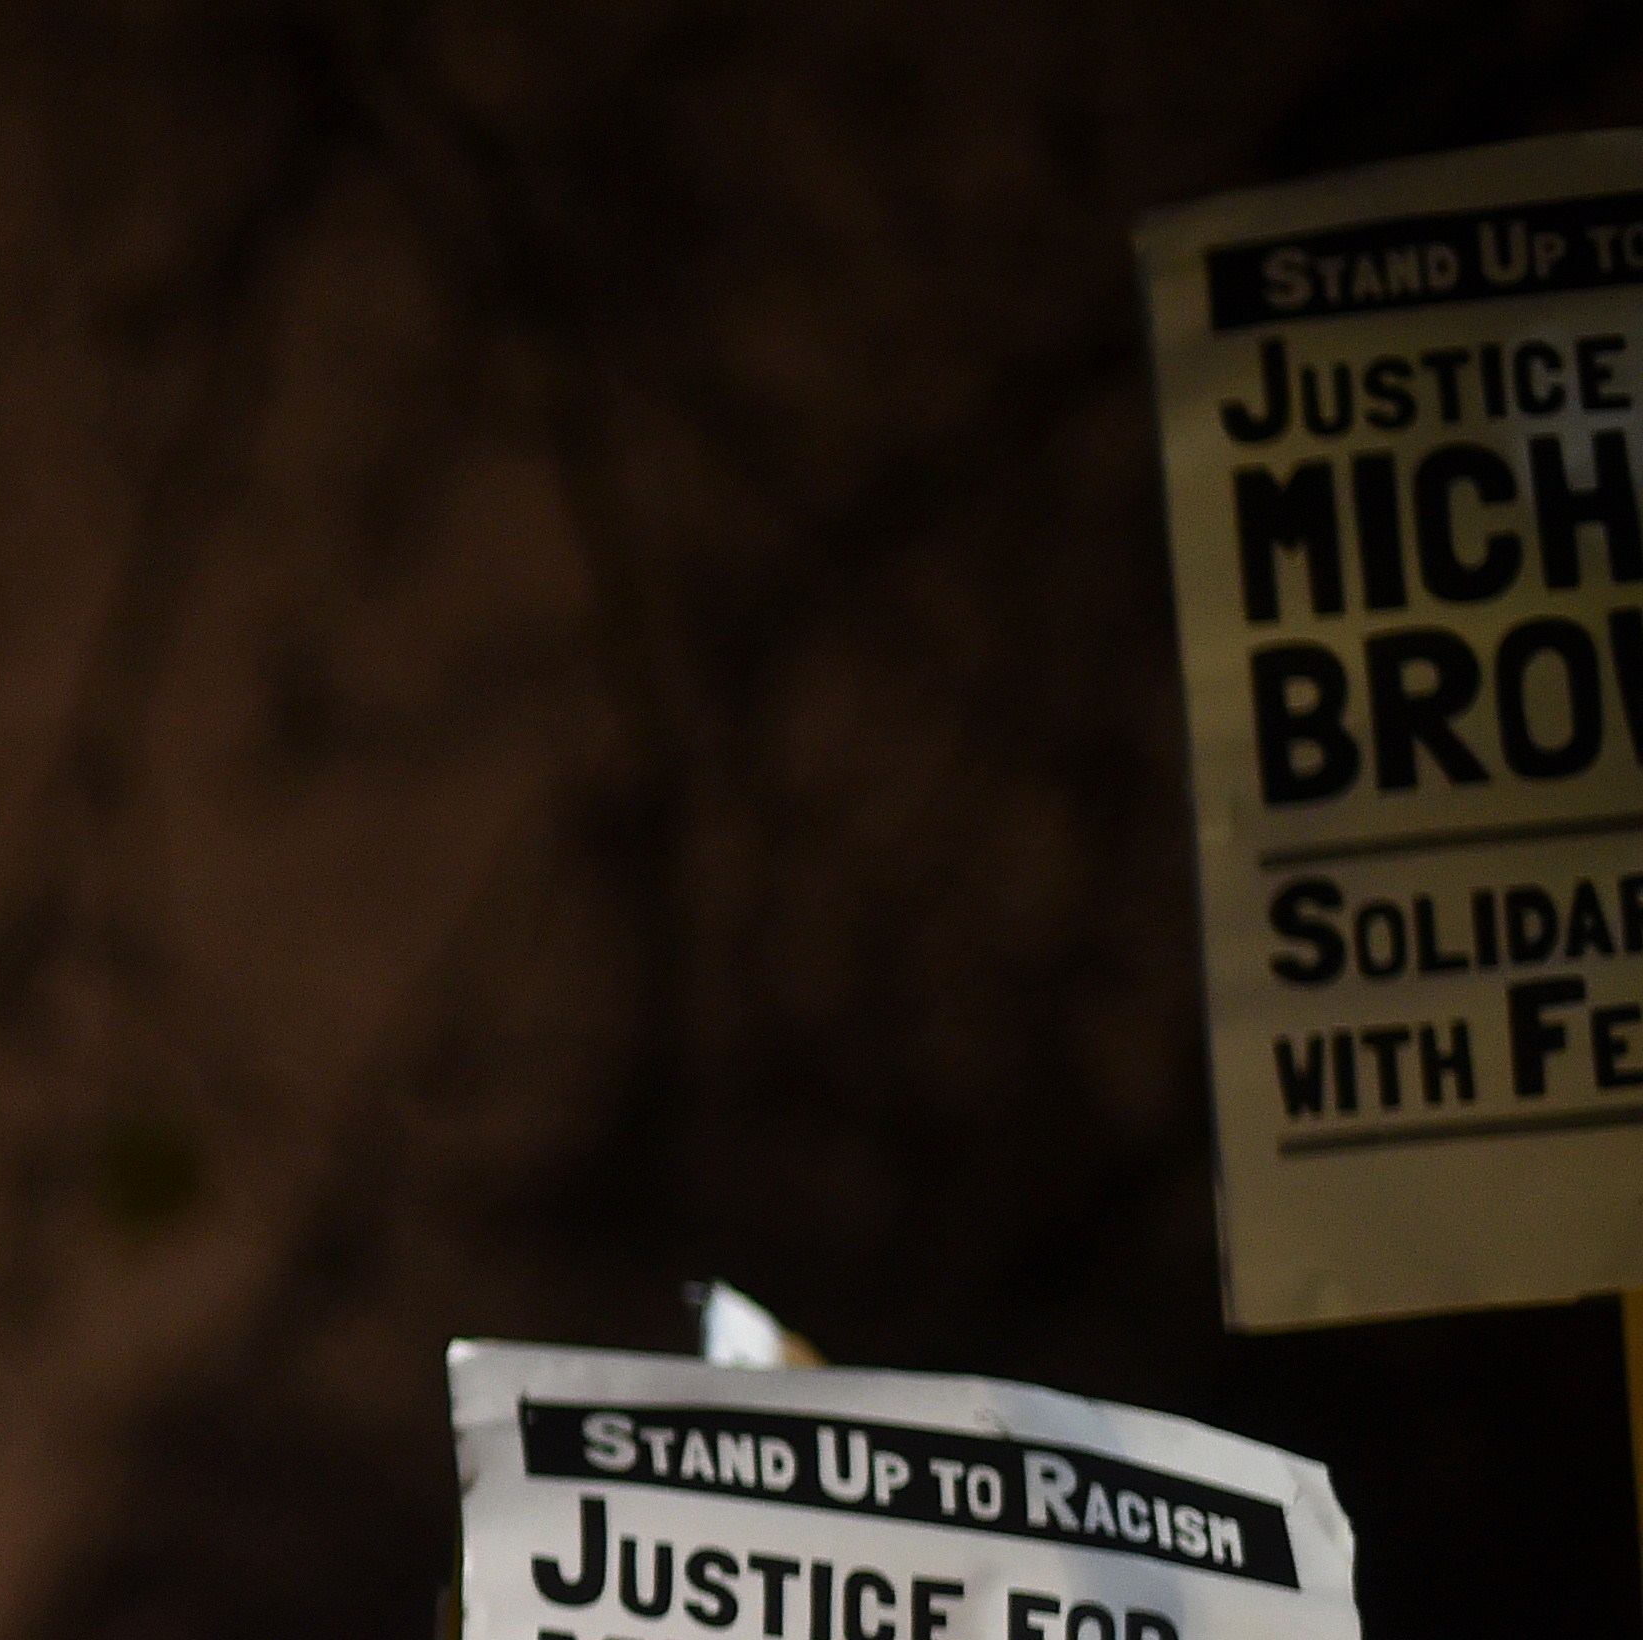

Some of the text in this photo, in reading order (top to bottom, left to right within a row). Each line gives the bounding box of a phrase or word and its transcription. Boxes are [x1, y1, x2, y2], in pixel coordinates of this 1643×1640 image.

[1259, 244, 1462, 313] STAND
[1474, 216, 1568, 288] UP
[1222, 334, 1633, 444] JUSTICE
[1231, 424, 1643, 627] MICH
[1249, 608, 1643, 804] BRO
[1268, 874, 1643, 985] SOLIDA
[1272, 1016, 1476, 1119] WITH
[581, 1411, 1245, 1568] STAND UP TO RACISM
